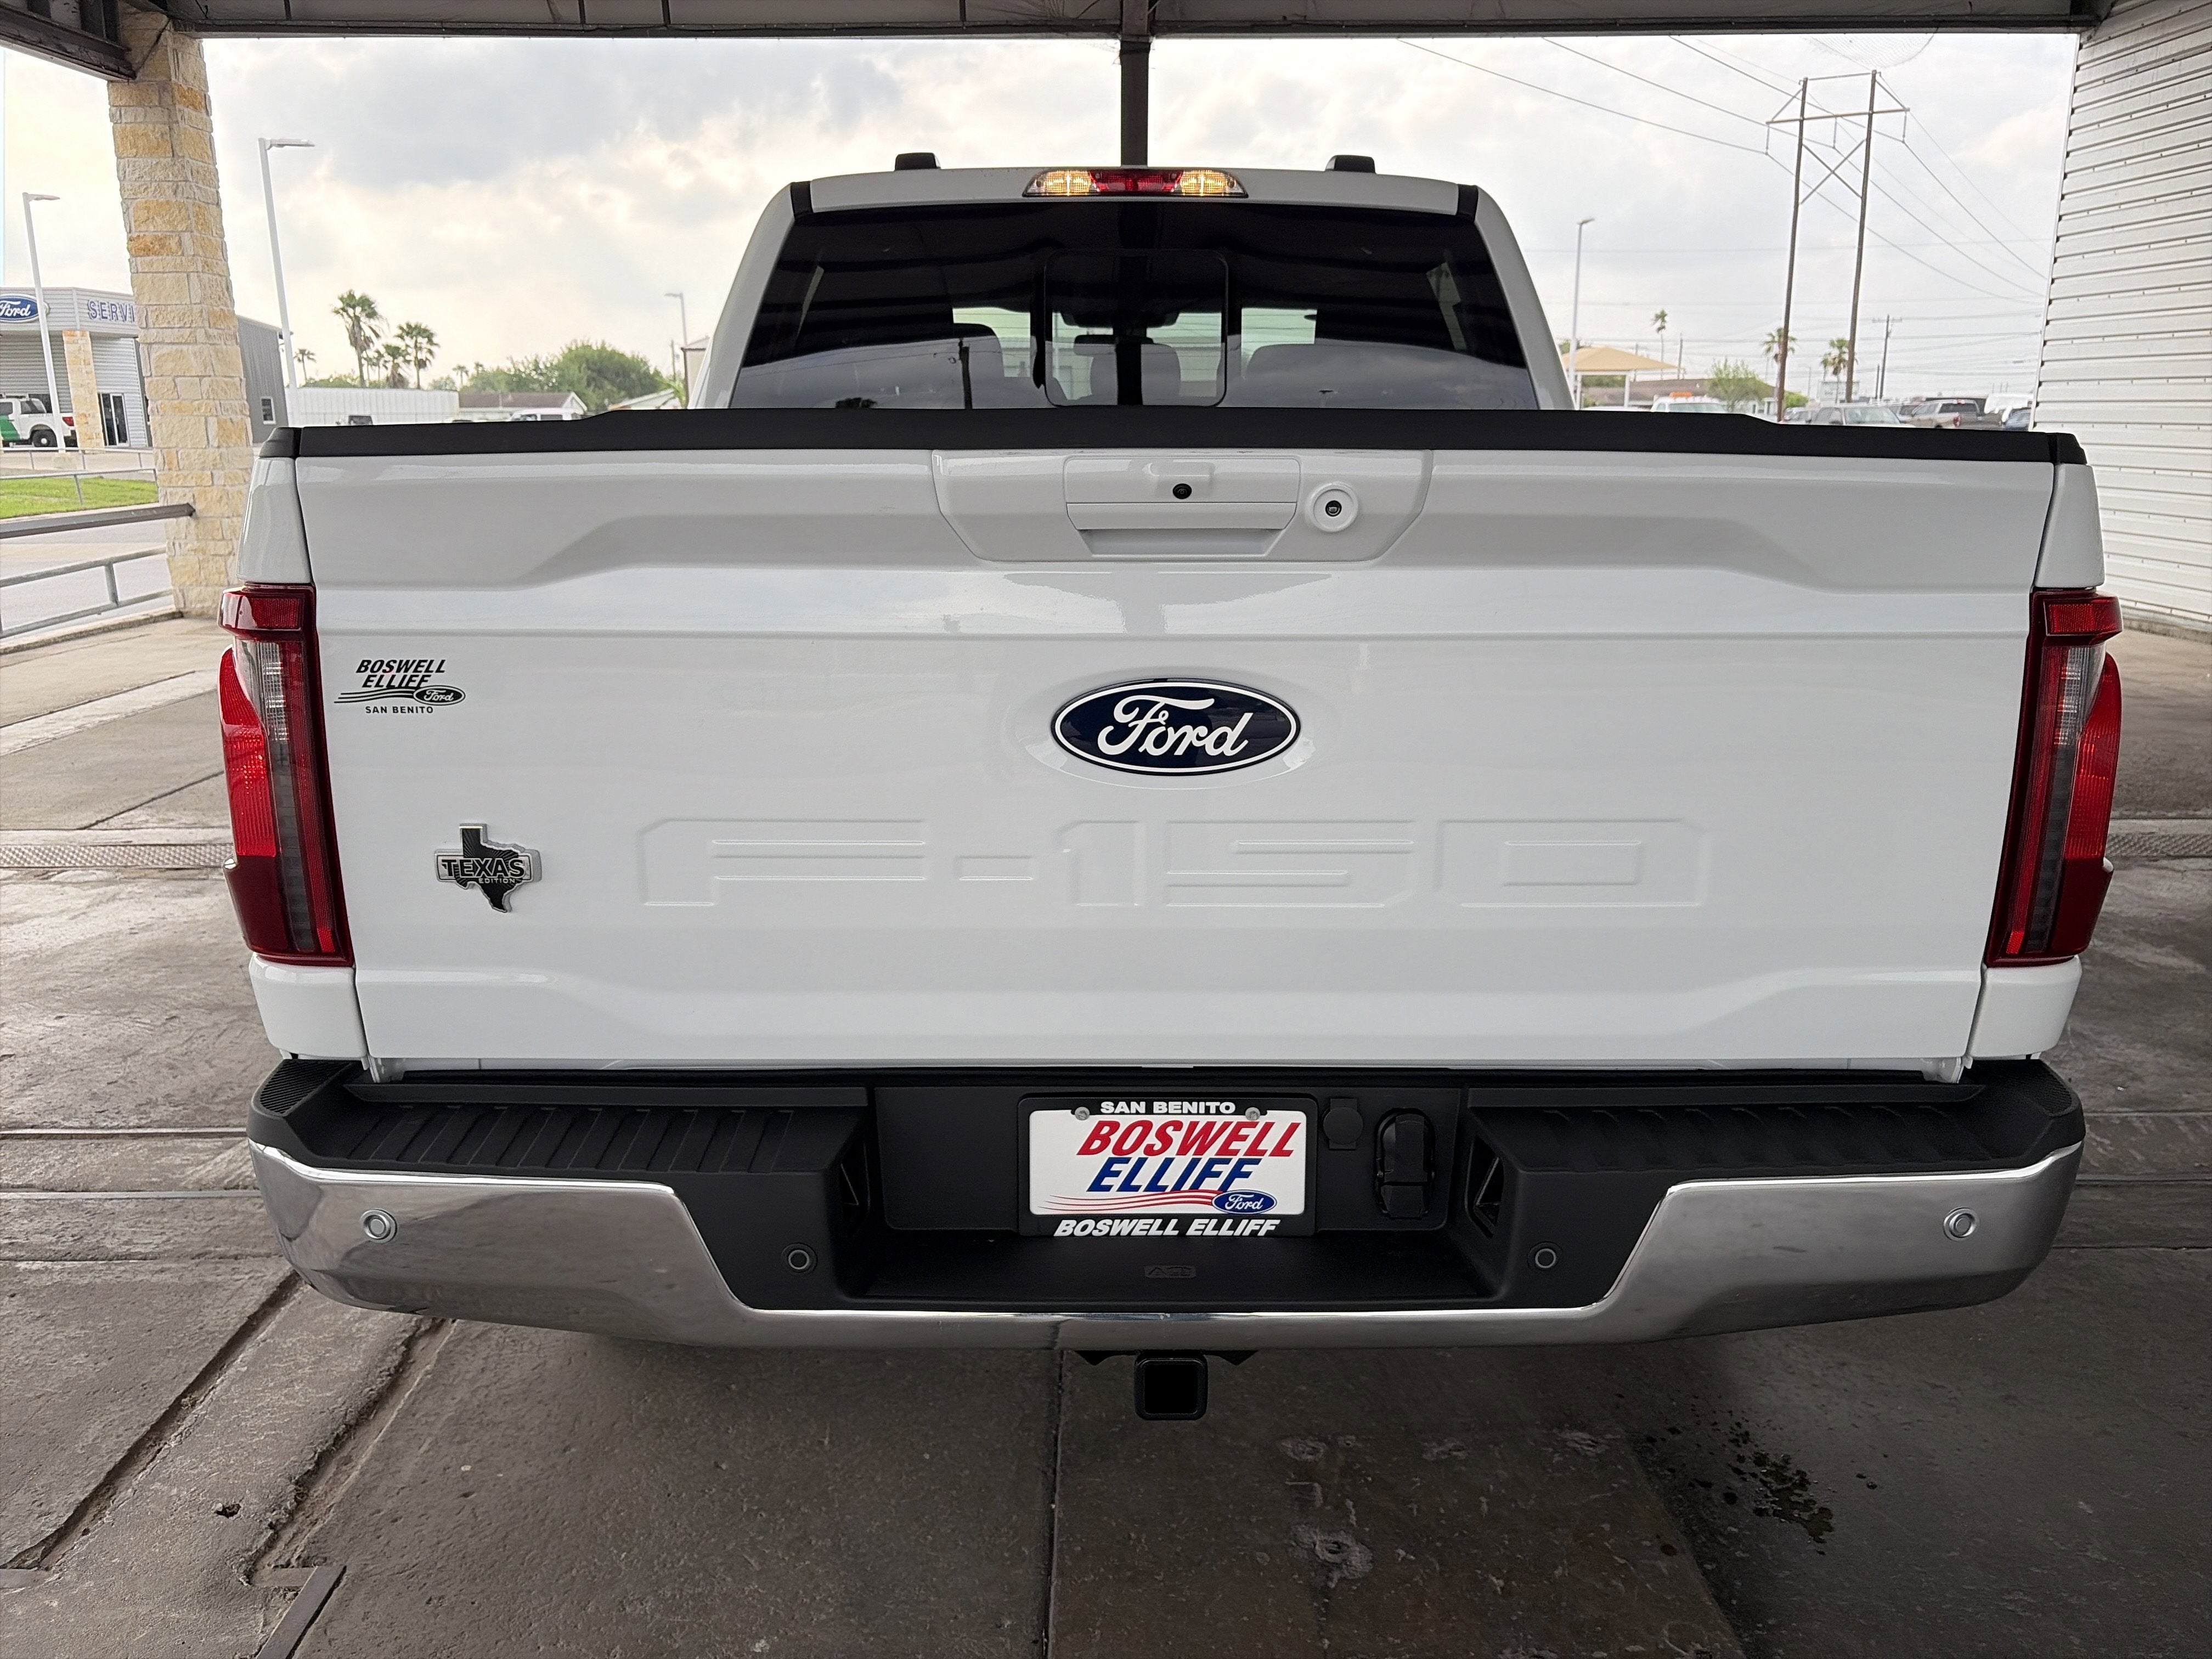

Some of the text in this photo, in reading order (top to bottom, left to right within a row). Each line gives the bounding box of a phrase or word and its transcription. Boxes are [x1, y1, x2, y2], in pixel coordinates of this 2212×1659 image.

[356, 659, 445, 673] BOSWELL
[362, 675, 431, 688] ELLIFF
[424, 690, 454, 701] Ford
[1097, 695, 1254, 756] Ford
[441, 857, 526, 878] TEXAS
[636, 817, 1711, 907] F-150
[1101, 1102, 1235, 1114] SAN BENITO
[1076, 1120, 1301, 1157] BOSWELL
[1086, 1156, 1264, 1192] ELLIFF
[1224, 1194, 1264, 1210] Ford
[1053, 1220, 1281, 1237] BOSWELL ELLIFF
